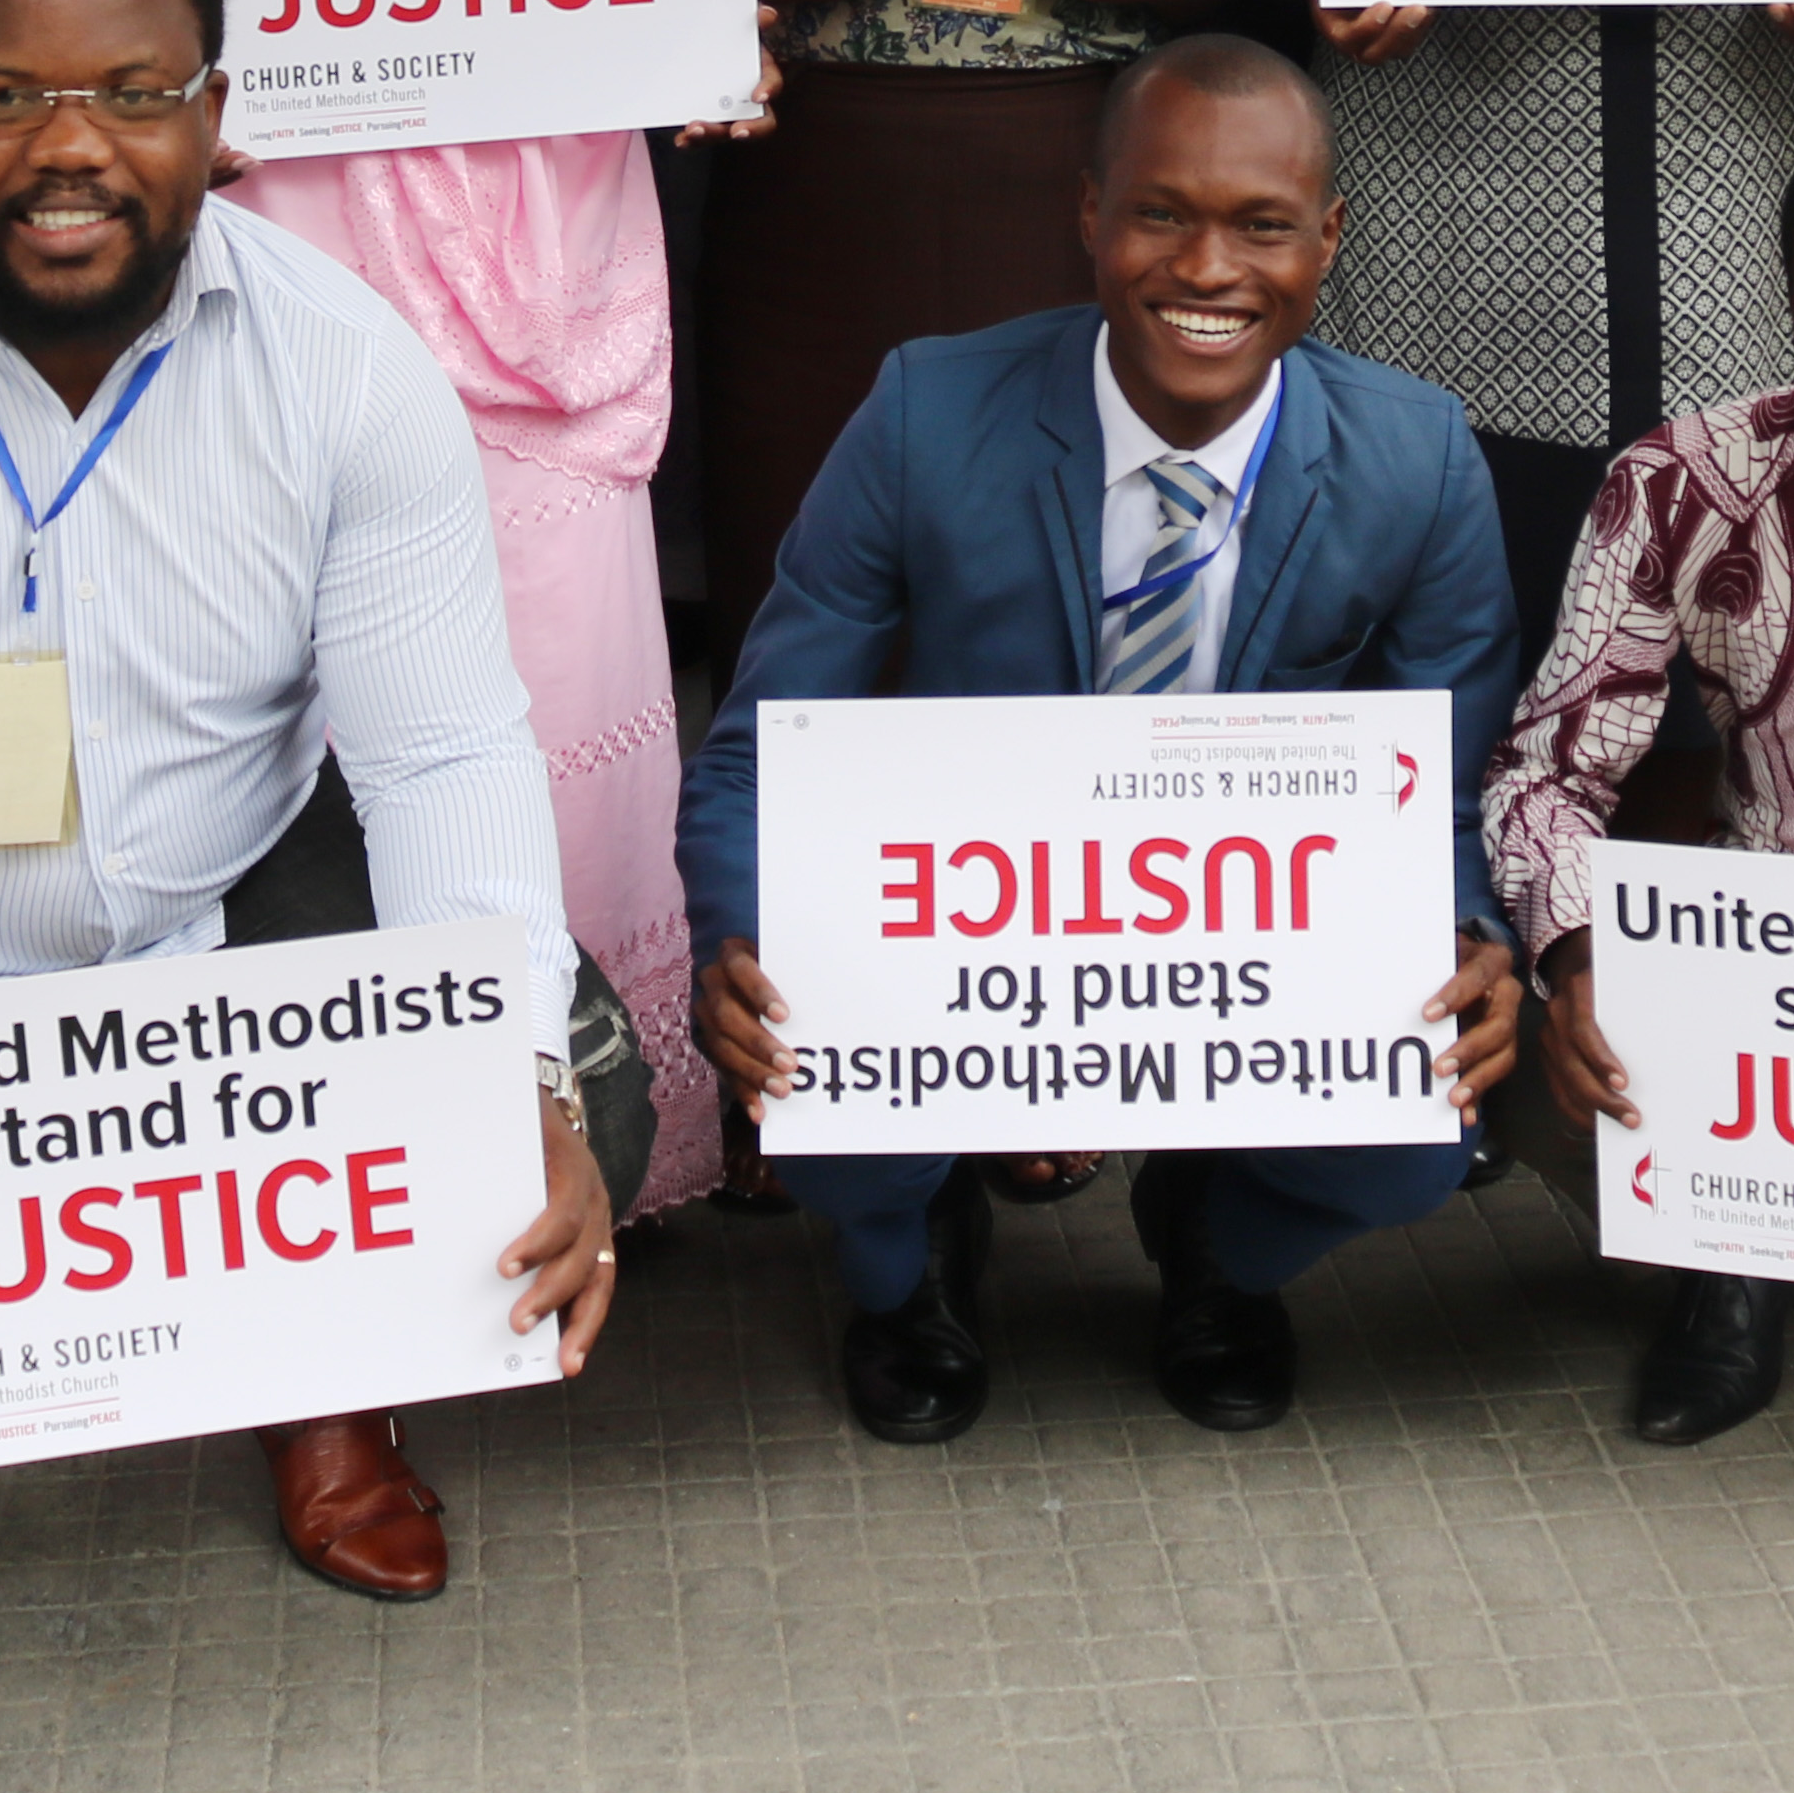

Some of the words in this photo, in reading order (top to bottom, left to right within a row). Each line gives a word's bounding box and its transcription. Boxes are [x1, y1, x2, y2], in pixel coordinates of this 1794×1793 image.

[243, 63, 339, 92] CHURCH
[353, 61, 365, 83] &
[378, 52, 475, 81] SOCIETY
[1093, 772, 1203, 799] SOCIETY
[1219, 772, 1233, 795] &
[1249, 769, 1357, 796] CHURCH
[881, 835, 1337, 937] JUSTICE
[947, 965, 1047, 1028] for
[1074, 961, 1269, 1026] stand
[59, 971, 503, 1077] Methodists
[792, 1035, 1175, 1108] Methodists
[1205, 1036, 1432, 1101] United
[214, 1073, 326, 1138] for
[1691, 1204, 1715, 1221] The
[1721, 1207, 1765, 1227] United
[22, 1345, 38, 1371] &
[55, 1323, 181, 1367] SOCIETY
[61, 1371, 119, 1395] Church
